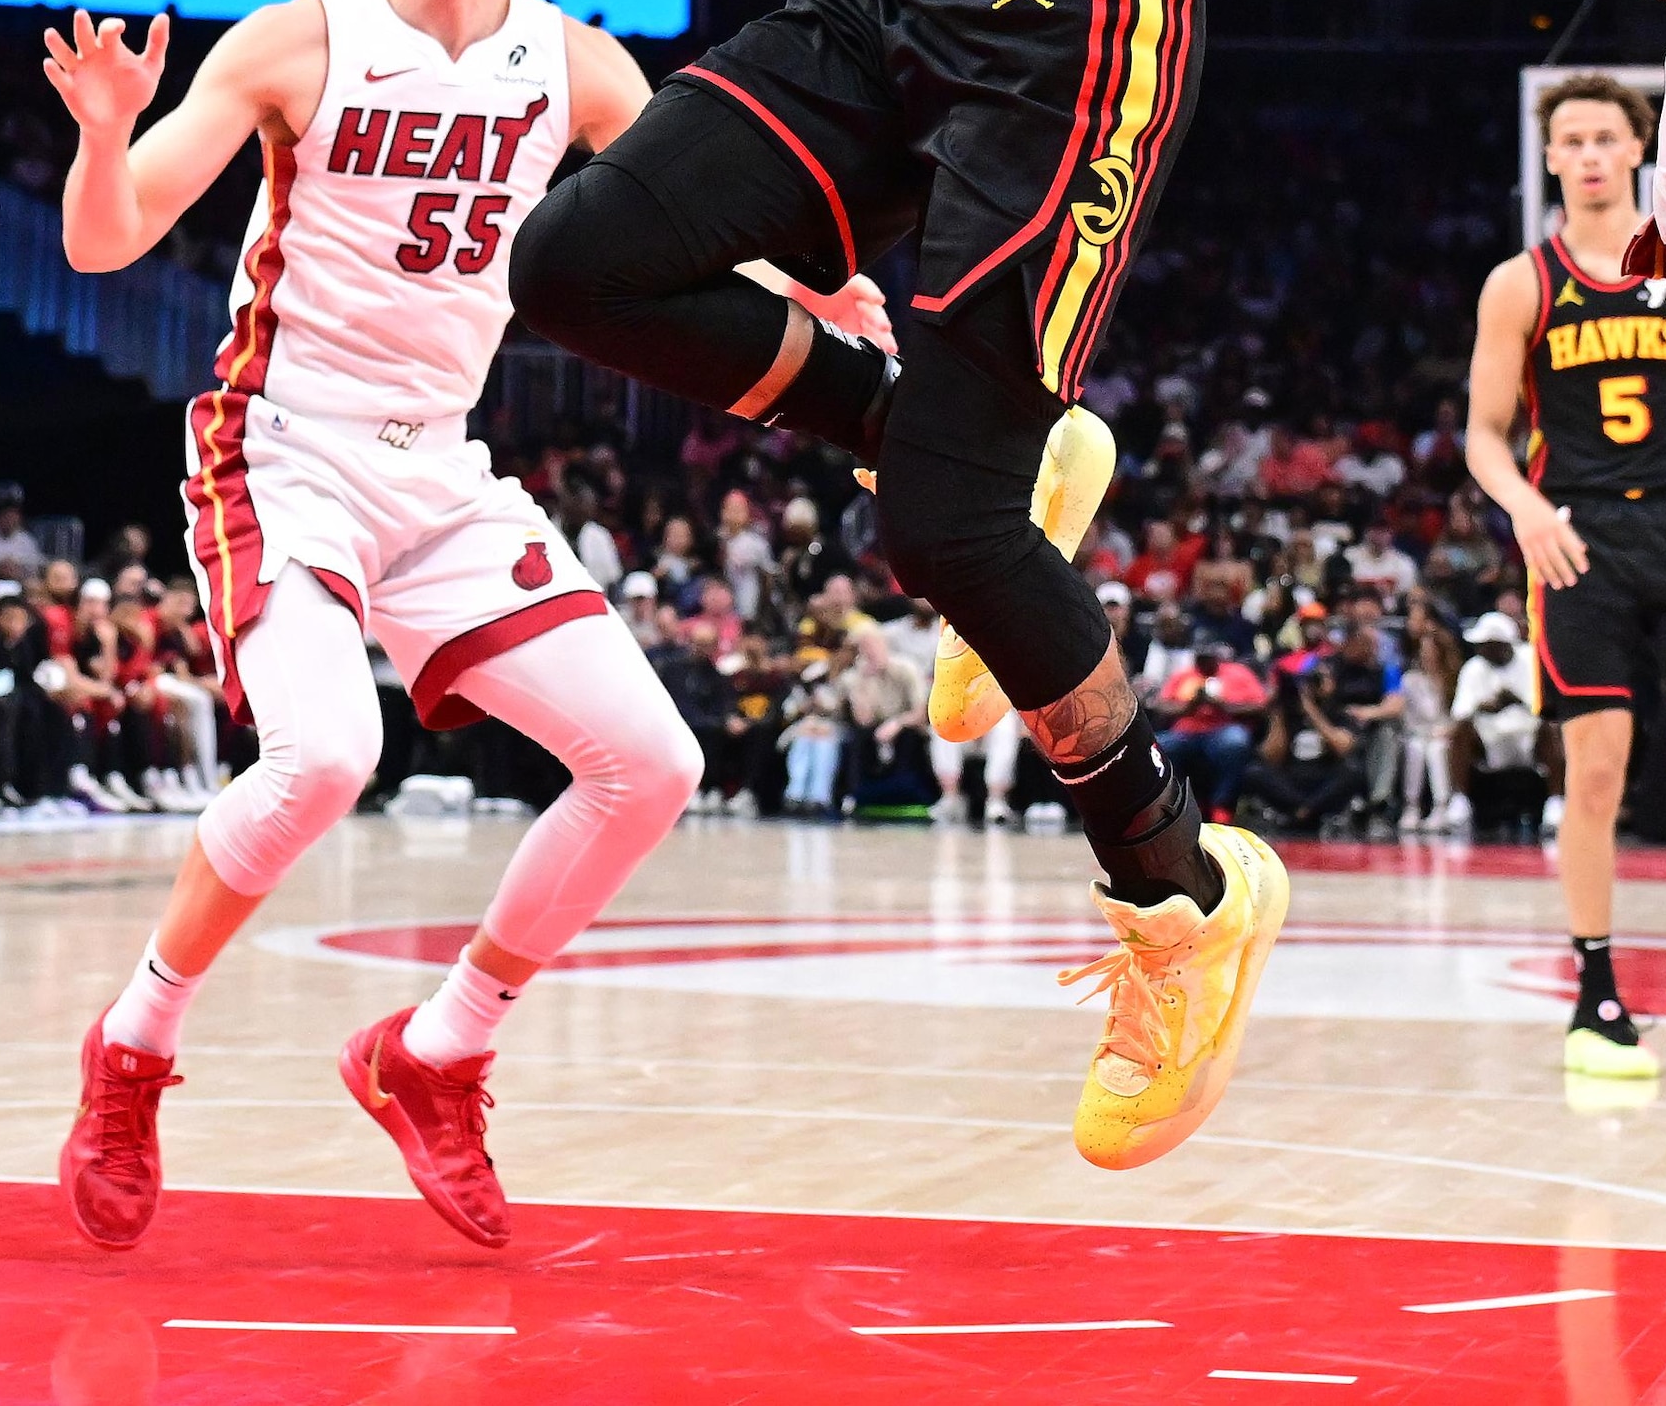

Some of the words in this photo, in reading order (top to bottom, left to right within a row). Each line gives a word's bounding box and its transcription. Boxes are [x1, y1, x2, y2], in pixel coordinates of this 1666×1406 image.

[327, 91, 549, 183] HEAT
[395, 191, 512, 275] 55
[1597, 374, 1654, 445] 5
